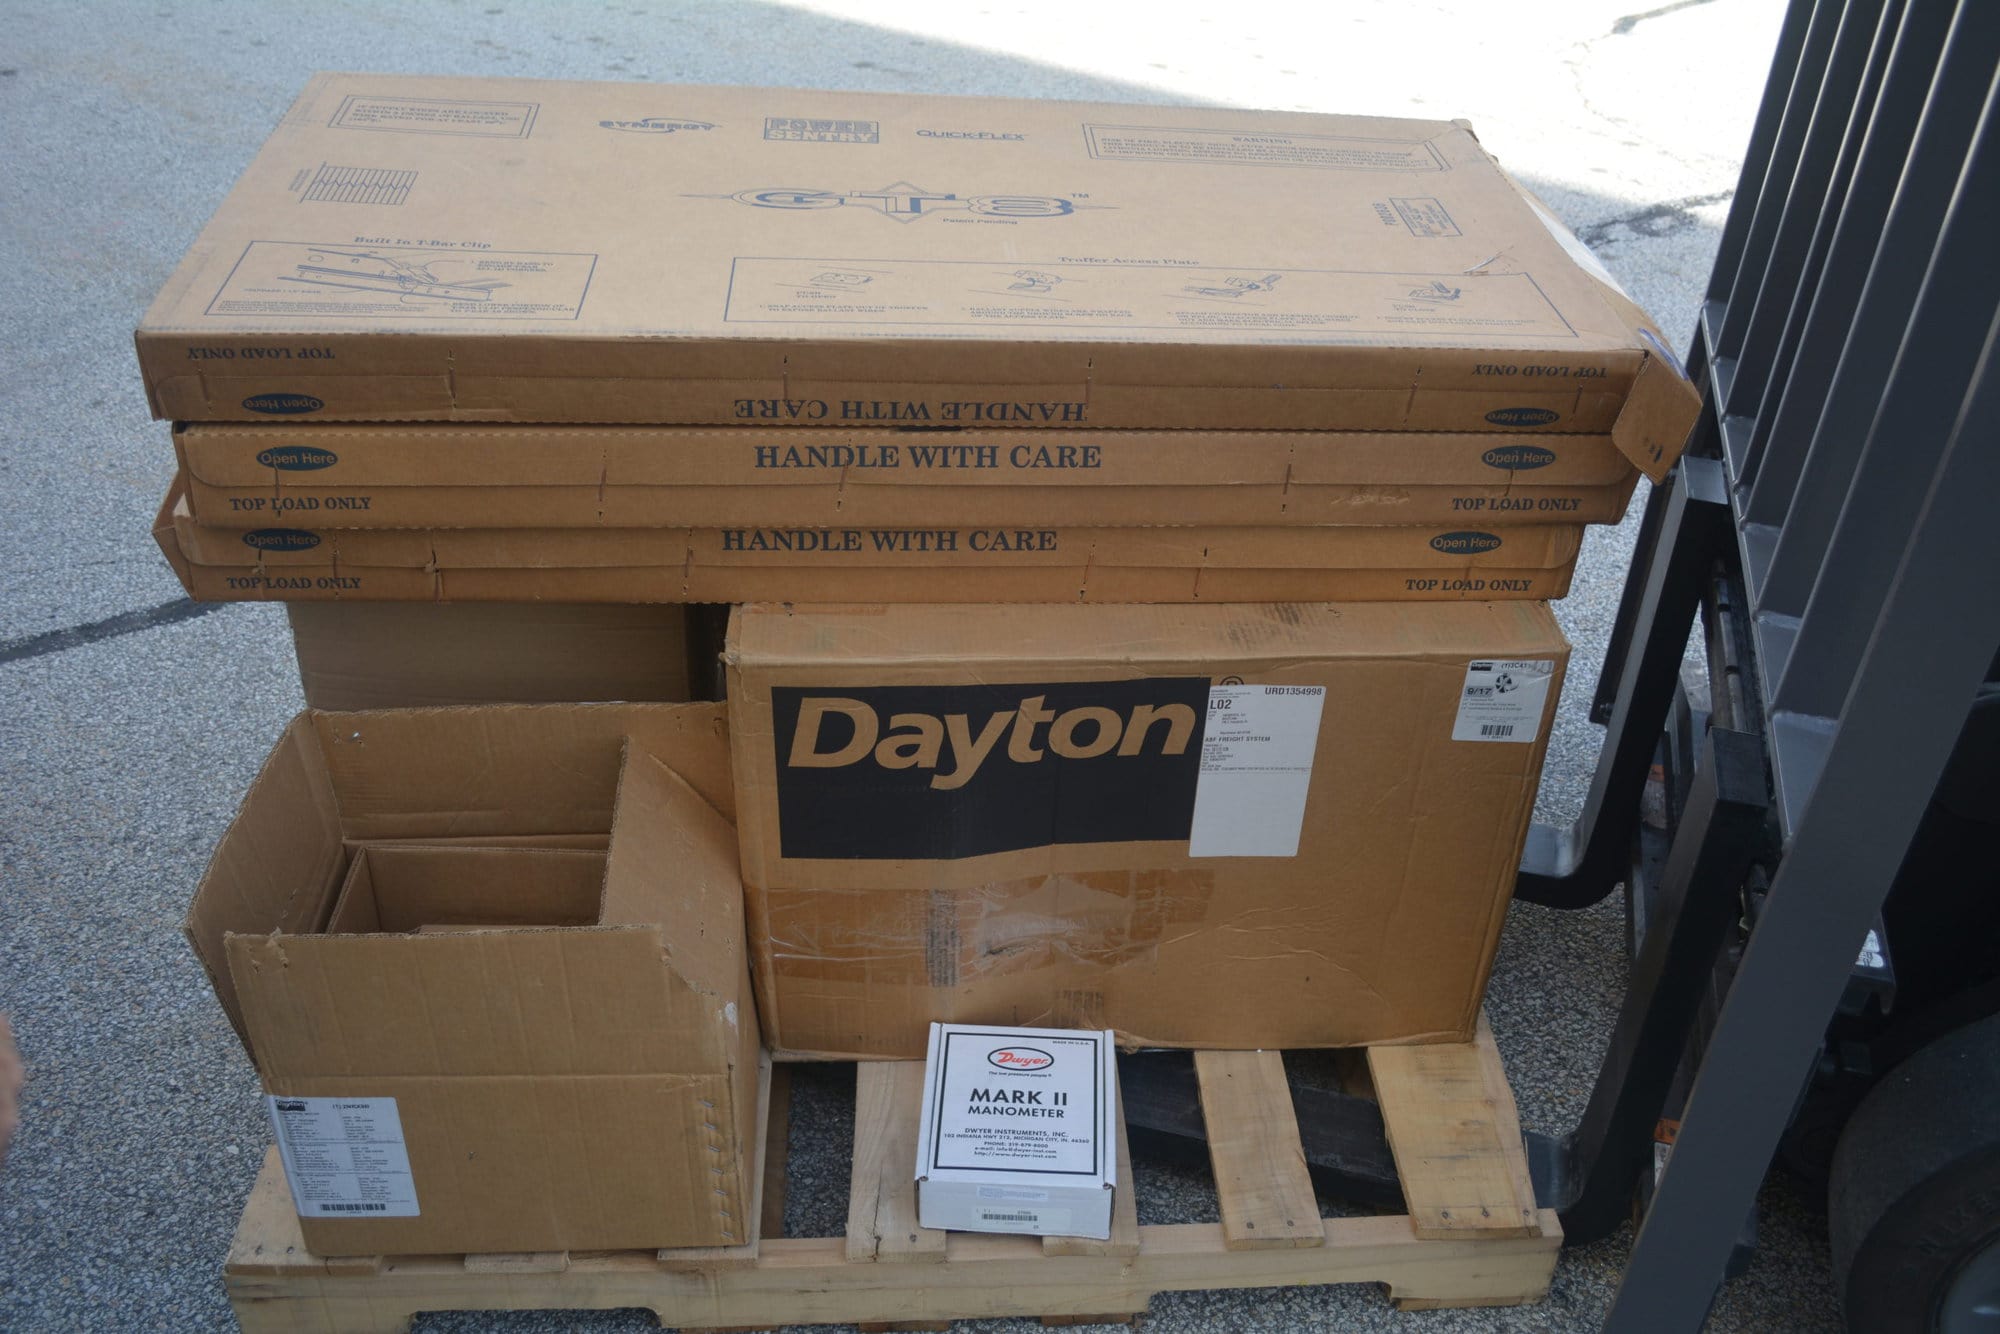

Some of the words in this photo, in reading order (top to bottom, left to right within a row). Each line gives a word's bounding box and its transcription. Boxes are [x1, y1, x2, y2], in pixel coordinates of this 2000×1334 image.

[769, 118, 877, 132] POWER
[767, 131, 875, 143] SENTRY
[354, 236, 390, 244] Built
[416, 239, 457, 247] T-Bar
[460, 241, 492, 249] Clip
[1113, 257, 1160, 265] Access
[187, 347, 236, 359] ONLY
[241, 347, 292, 359] LOAD
[298, 347, 335, 359] TOP
[1472, 365, 1516, 376] ONLY
[1522, 366, 1569, 377] LOAD
[1573, 367, 1608, 378] TOP
[245, 399, 279, 409] Here
[281, 399, 321, 410] Open
[734, 399, 828, 419] CARE
[841, 401, 932, 420] WITH
[941, 403, 1085, 422] HANDLE
[1489, 412, 1519, 422] Here
[1521, 412, 1557, 424] Open
[261, 453, 298, 465] Open
[302, 453, 335, 464] Here
[755, 445, 899, 468] HANDLE
[908, 445, 999, 468] WITH
[1009, 445, 1101, 468] CARE
[1485, 452, 1519, 464] Open
[1523, 452, 1553, 463] Here
[229, 497, 266, 511] TOP
[270, 497, 320, 511] LOAD
[324, 497, 371, 511] ONLY
[1452, 498, 1485, 511] TOP
[1489, 498, 1534, 511] LOAD
[1538, 498, 1581, 511] ONLY
[246, 534, 281, 547] Open
[286, 534, 319, 545] Here
[722, 530, 862, 551] HANDLE
[870, 530, 958, 551] WITH
[968, 530, 1057, 551] CARE
[1434, 537, 1467, 549] Open
[1470, 537, 1500, 548] Here
[227, 577, 261, 589] TOP
[264, 577, 313, 589] LOAD
[317, 577, 361, 589] ONLY
[1406, 579, 1438, 591] TOP
[1441, 579, 1485, 591] LOAD
[1489, 579, 1532, 591] ONLY
[1265, 687, 1323, 696] URD1354998
[1210, 699, 1232, 710] L02
[787, 694, 1197, 791] Dayton
[969, 1088, 1042, 1105] MARK
[1053, 1092, 1067, 1106] II
[967, 1106, 1065, 1118] MANOMETER
[994, 1128, 1050, 1138] INSTRUMENTS,
